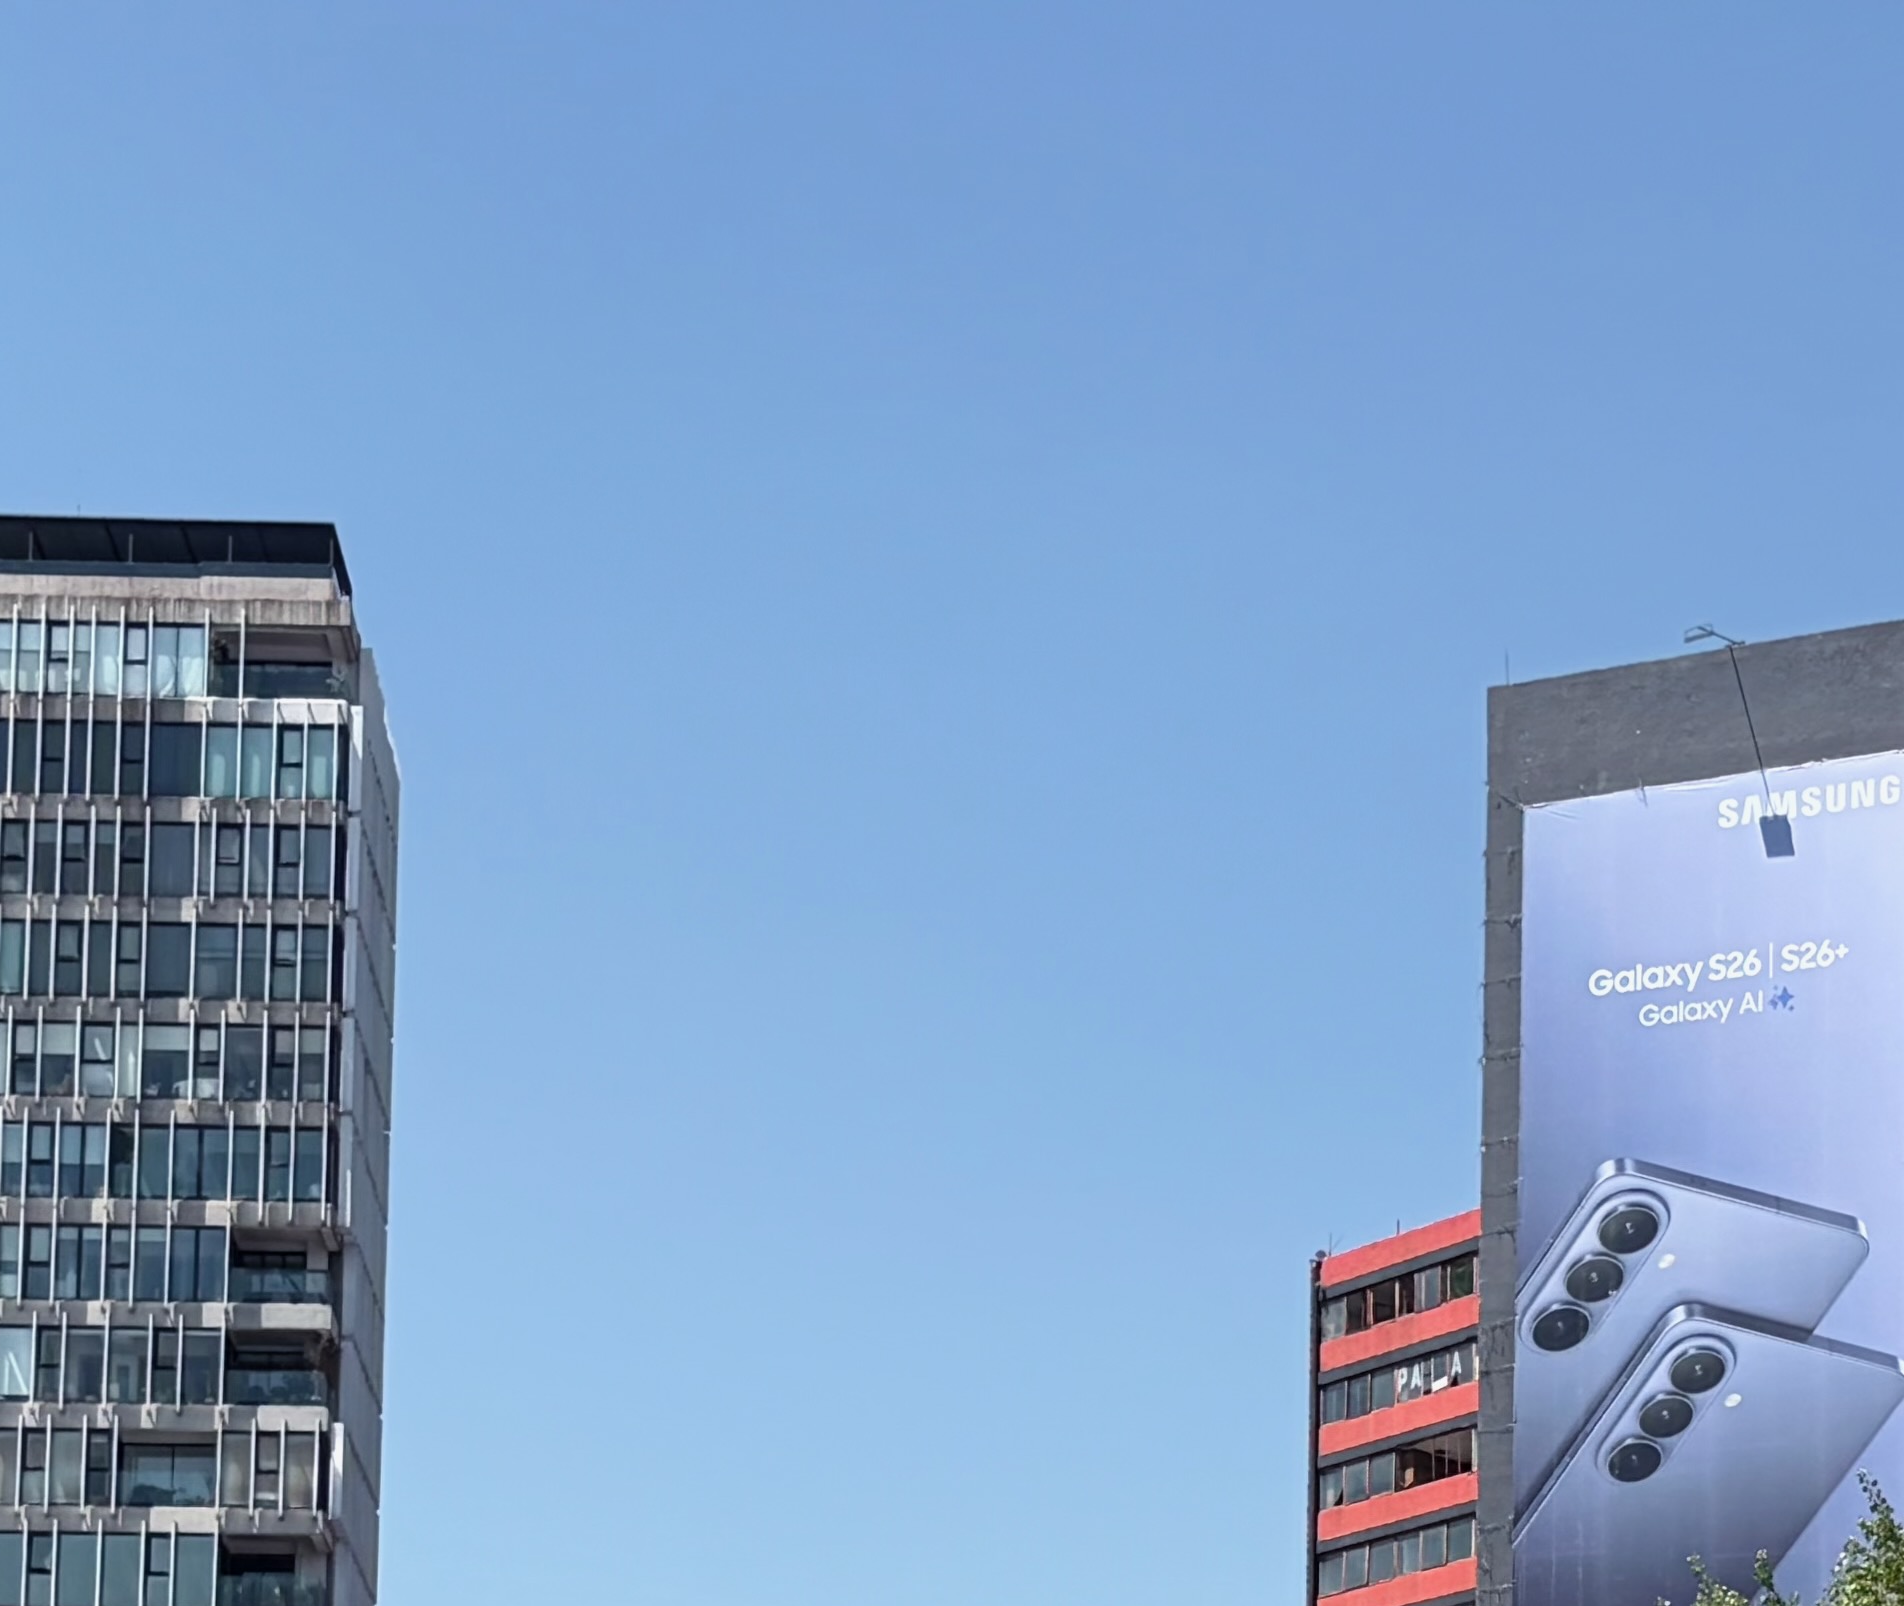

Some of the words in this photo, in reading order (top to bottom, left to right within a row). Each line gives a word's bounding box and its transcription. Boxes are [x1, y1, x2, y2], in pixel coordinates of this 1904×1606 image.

[1717, 775, 1902, 830] SAMSUNG
[1587, 958, 1704, 999] Galaxy
[1708, 948, 1763, 982] S26
[1780, 940, 1850, 973] S26+
[1637, 995, 1733, 1030] Galaxy
[1739, 989, 1764, 1015] AI
